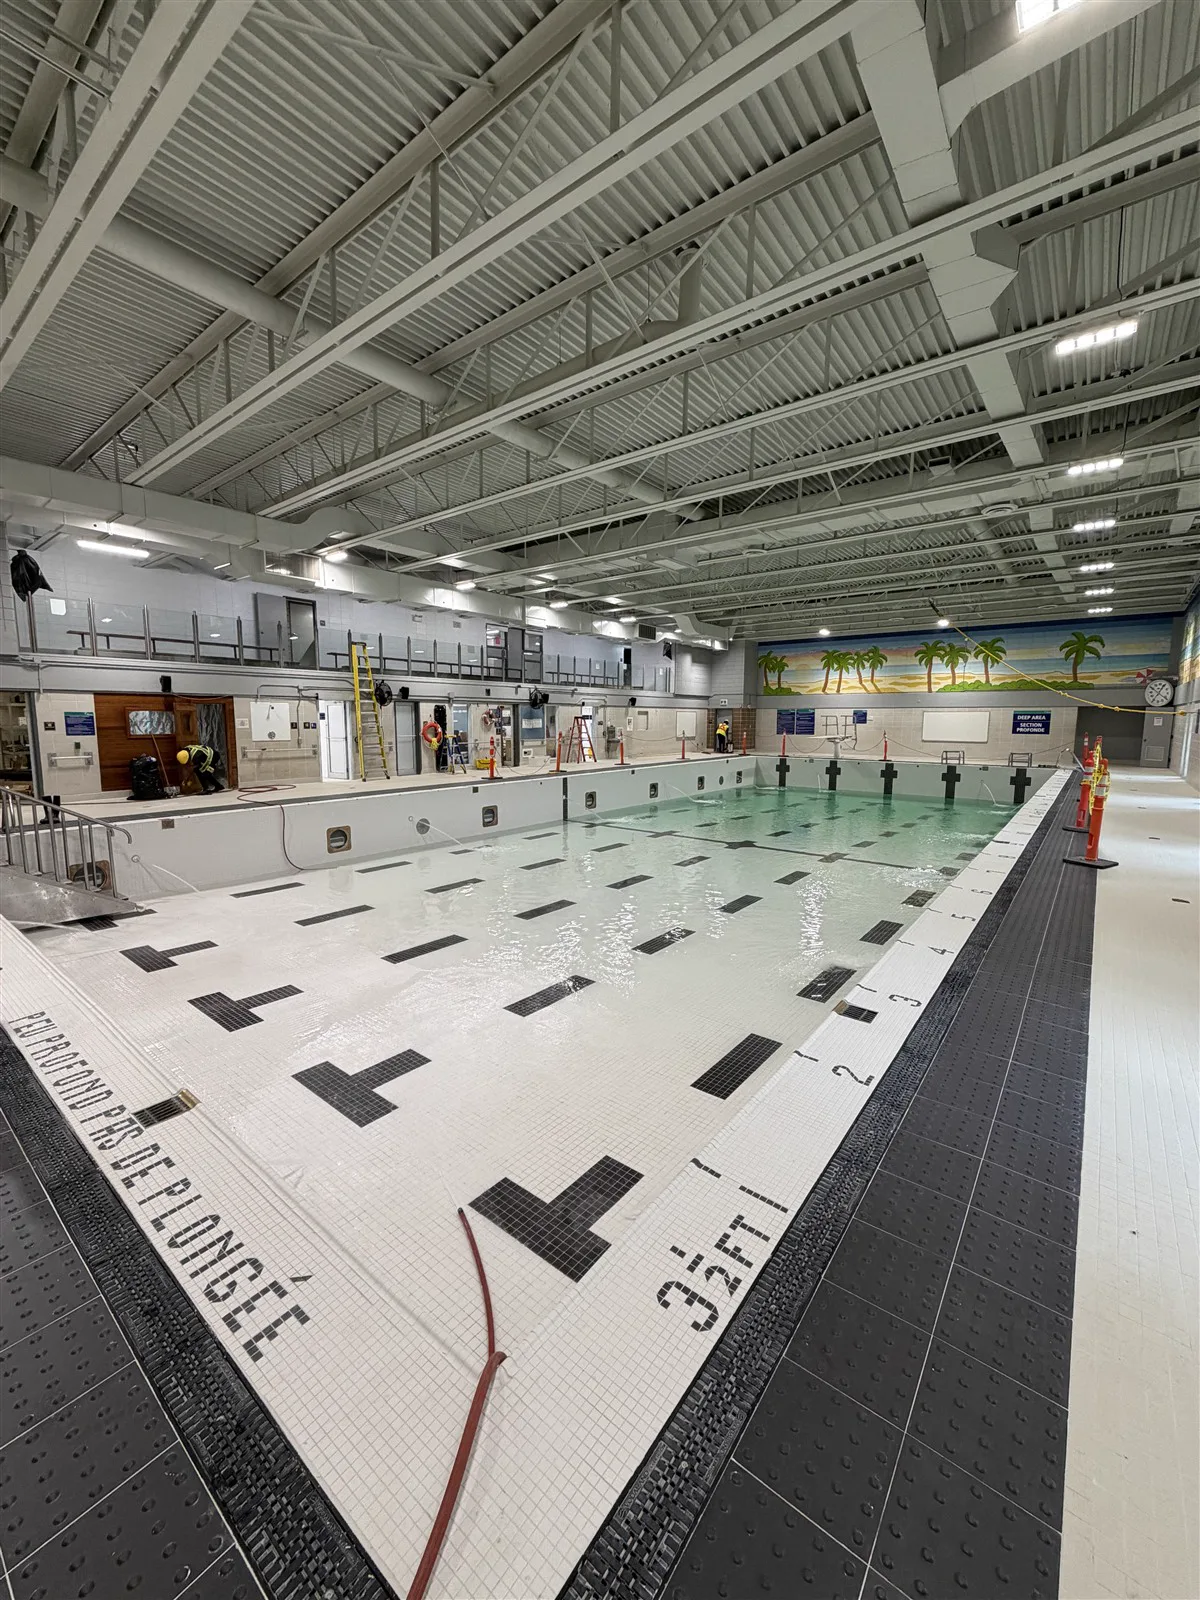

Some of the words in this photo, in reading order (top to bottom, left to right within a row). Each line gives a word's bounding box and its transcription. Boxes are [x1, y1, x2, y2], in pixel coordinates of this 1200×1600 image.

[951, 912, 976, 922] 5
[928, 945, 955, 956] 4
[888, 994, 922, 1008] 3
[8, 1011, 57, 1039] PEU
[25, 1033, 114, 1110] PROFOND
[831, 1064, 875, 1087] 2
[80, 1105, 145, 1151] PAS
[111, 1142, 175, 1189] DE
[139, 1177, 313, 1362] PLONGÉE
